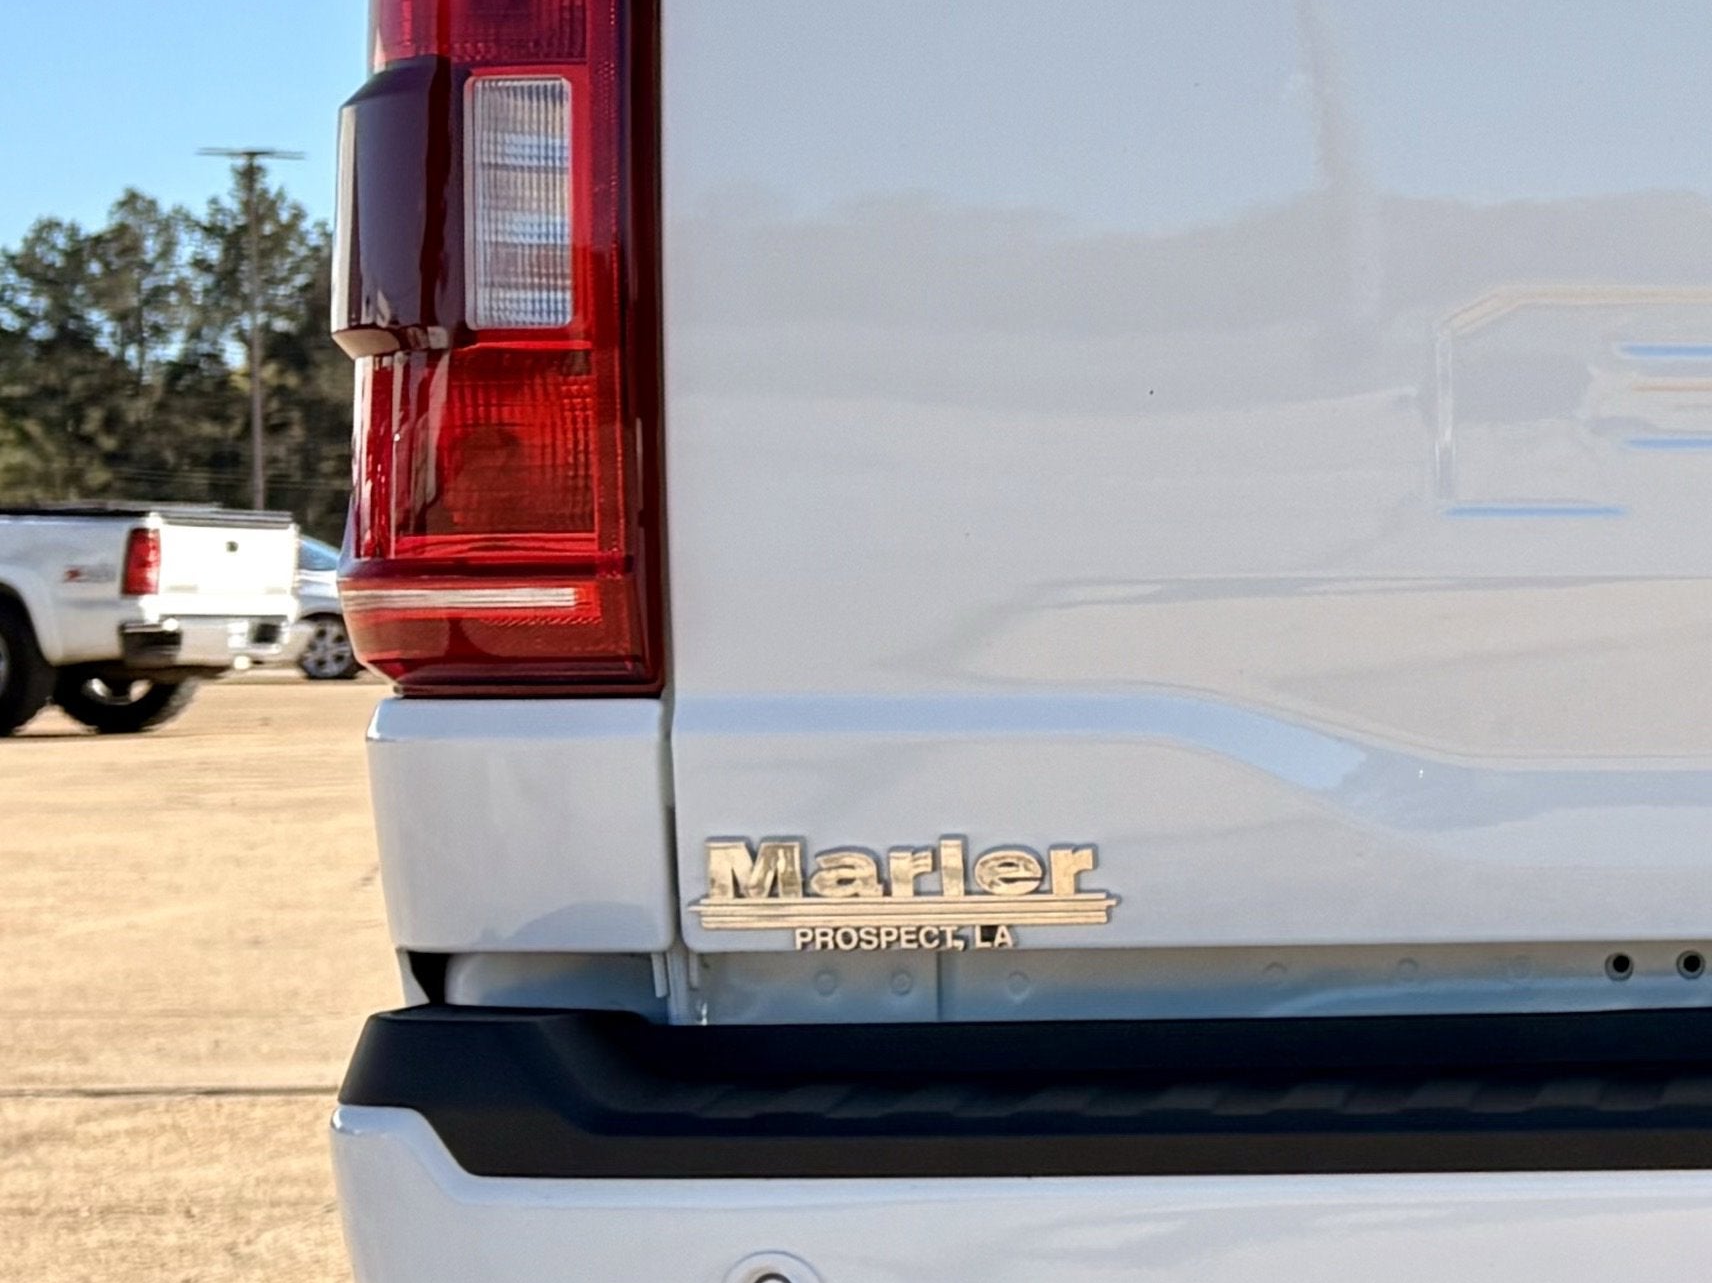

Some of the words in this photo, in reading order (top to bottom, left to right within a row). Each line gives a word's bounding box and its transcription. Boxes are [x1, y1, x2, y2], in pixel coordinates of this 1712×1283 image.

[704, 833, 1097, 899] Marler
[794, 926, 966, 952] PROSPECT,
[974, 925, 1015, 950] LA
